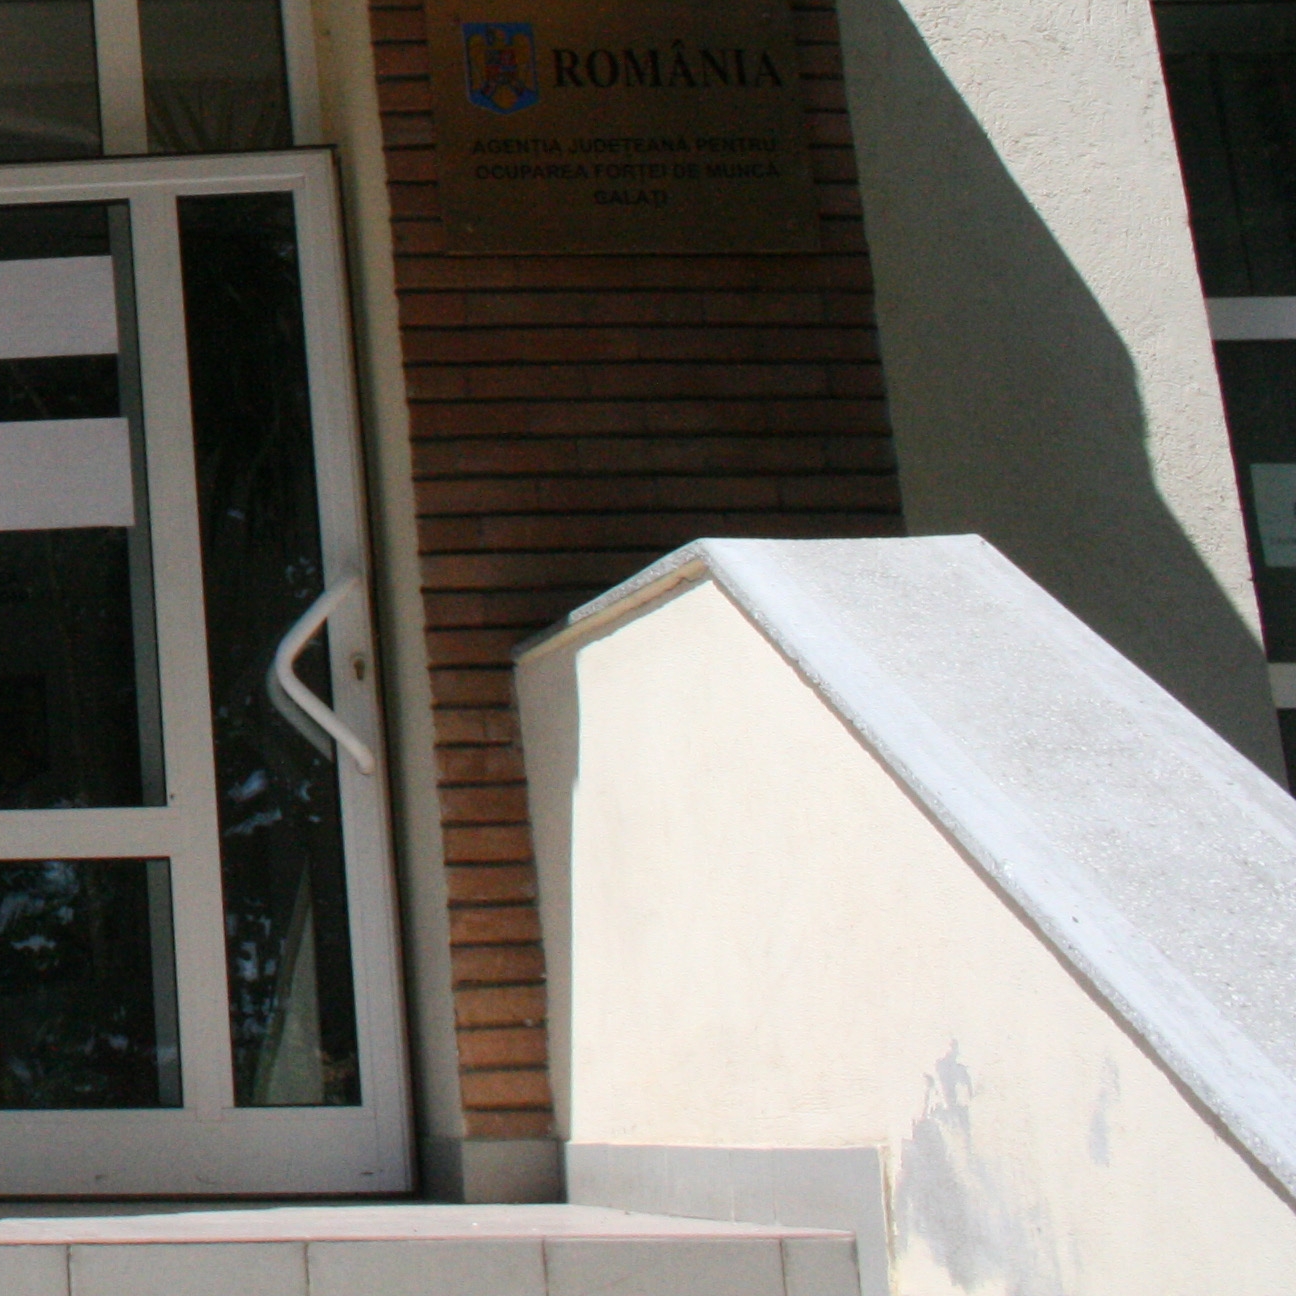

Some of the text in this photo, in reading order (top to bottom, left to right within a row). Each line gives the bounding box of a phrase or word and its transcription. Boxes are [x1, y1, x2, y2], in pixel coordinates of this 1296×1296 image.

[552, 38, 783, 88] ROMÂNIA
[696, 137, 777, 154] PENTRU
[475, 163, 589, 180] OCUPAREA
[674, 164, 699, 179] DE
